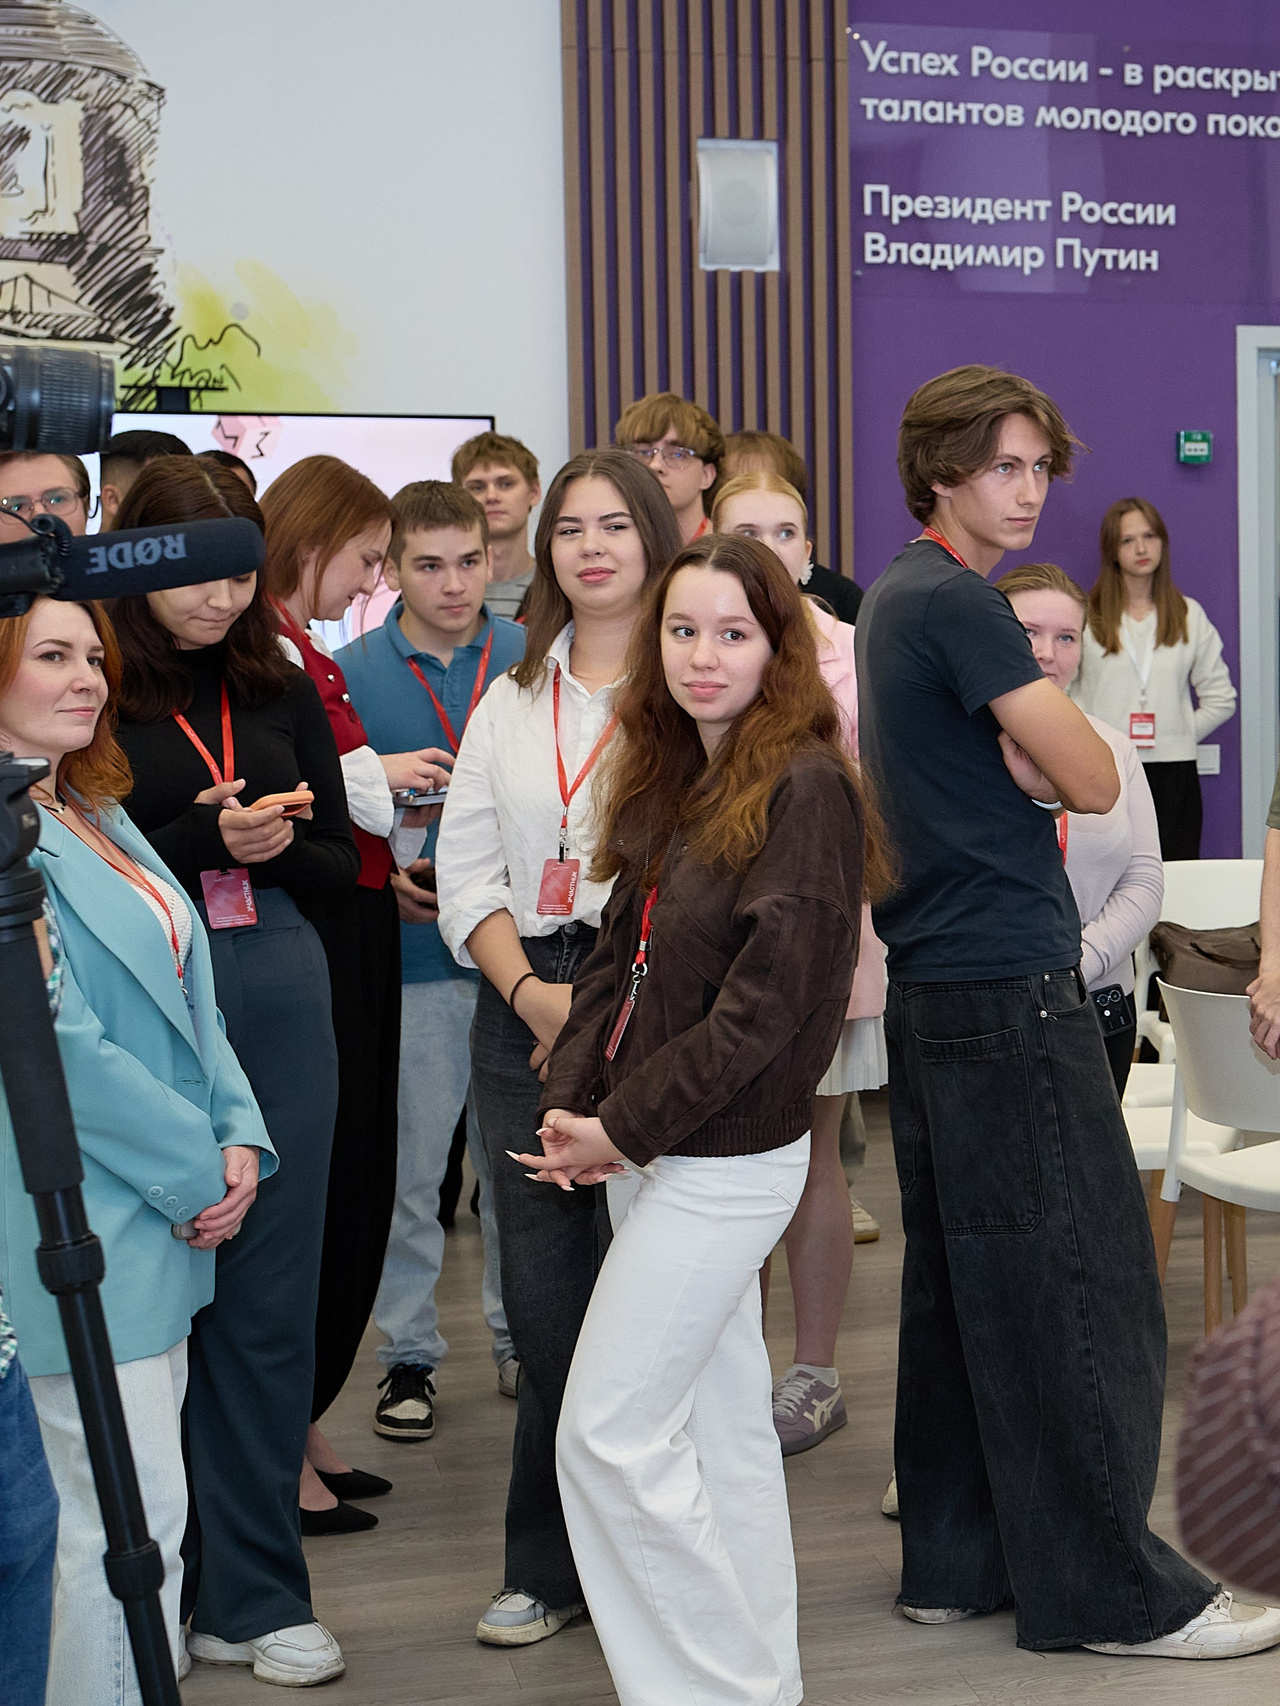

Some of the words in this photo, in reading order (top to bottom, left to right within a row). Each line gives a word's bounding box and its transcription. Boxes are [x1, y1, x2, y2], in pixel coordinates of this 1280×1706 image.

[859, 39, 960, 77] Успех
[970, 45, 1089, 83] России
[1099, 67, 1114, 76] -
[1123, 63, 1144, 86] в
[860, 97, 1025, 127] талантов
[1034, 105, 1198, 137] молодого
[863, 184, 1053, 225] Президент
[1060, 190, 1177, 226] России
[864, 231, 1046, 276] Владимир
[1055, 237, 1160, 278] Путин
